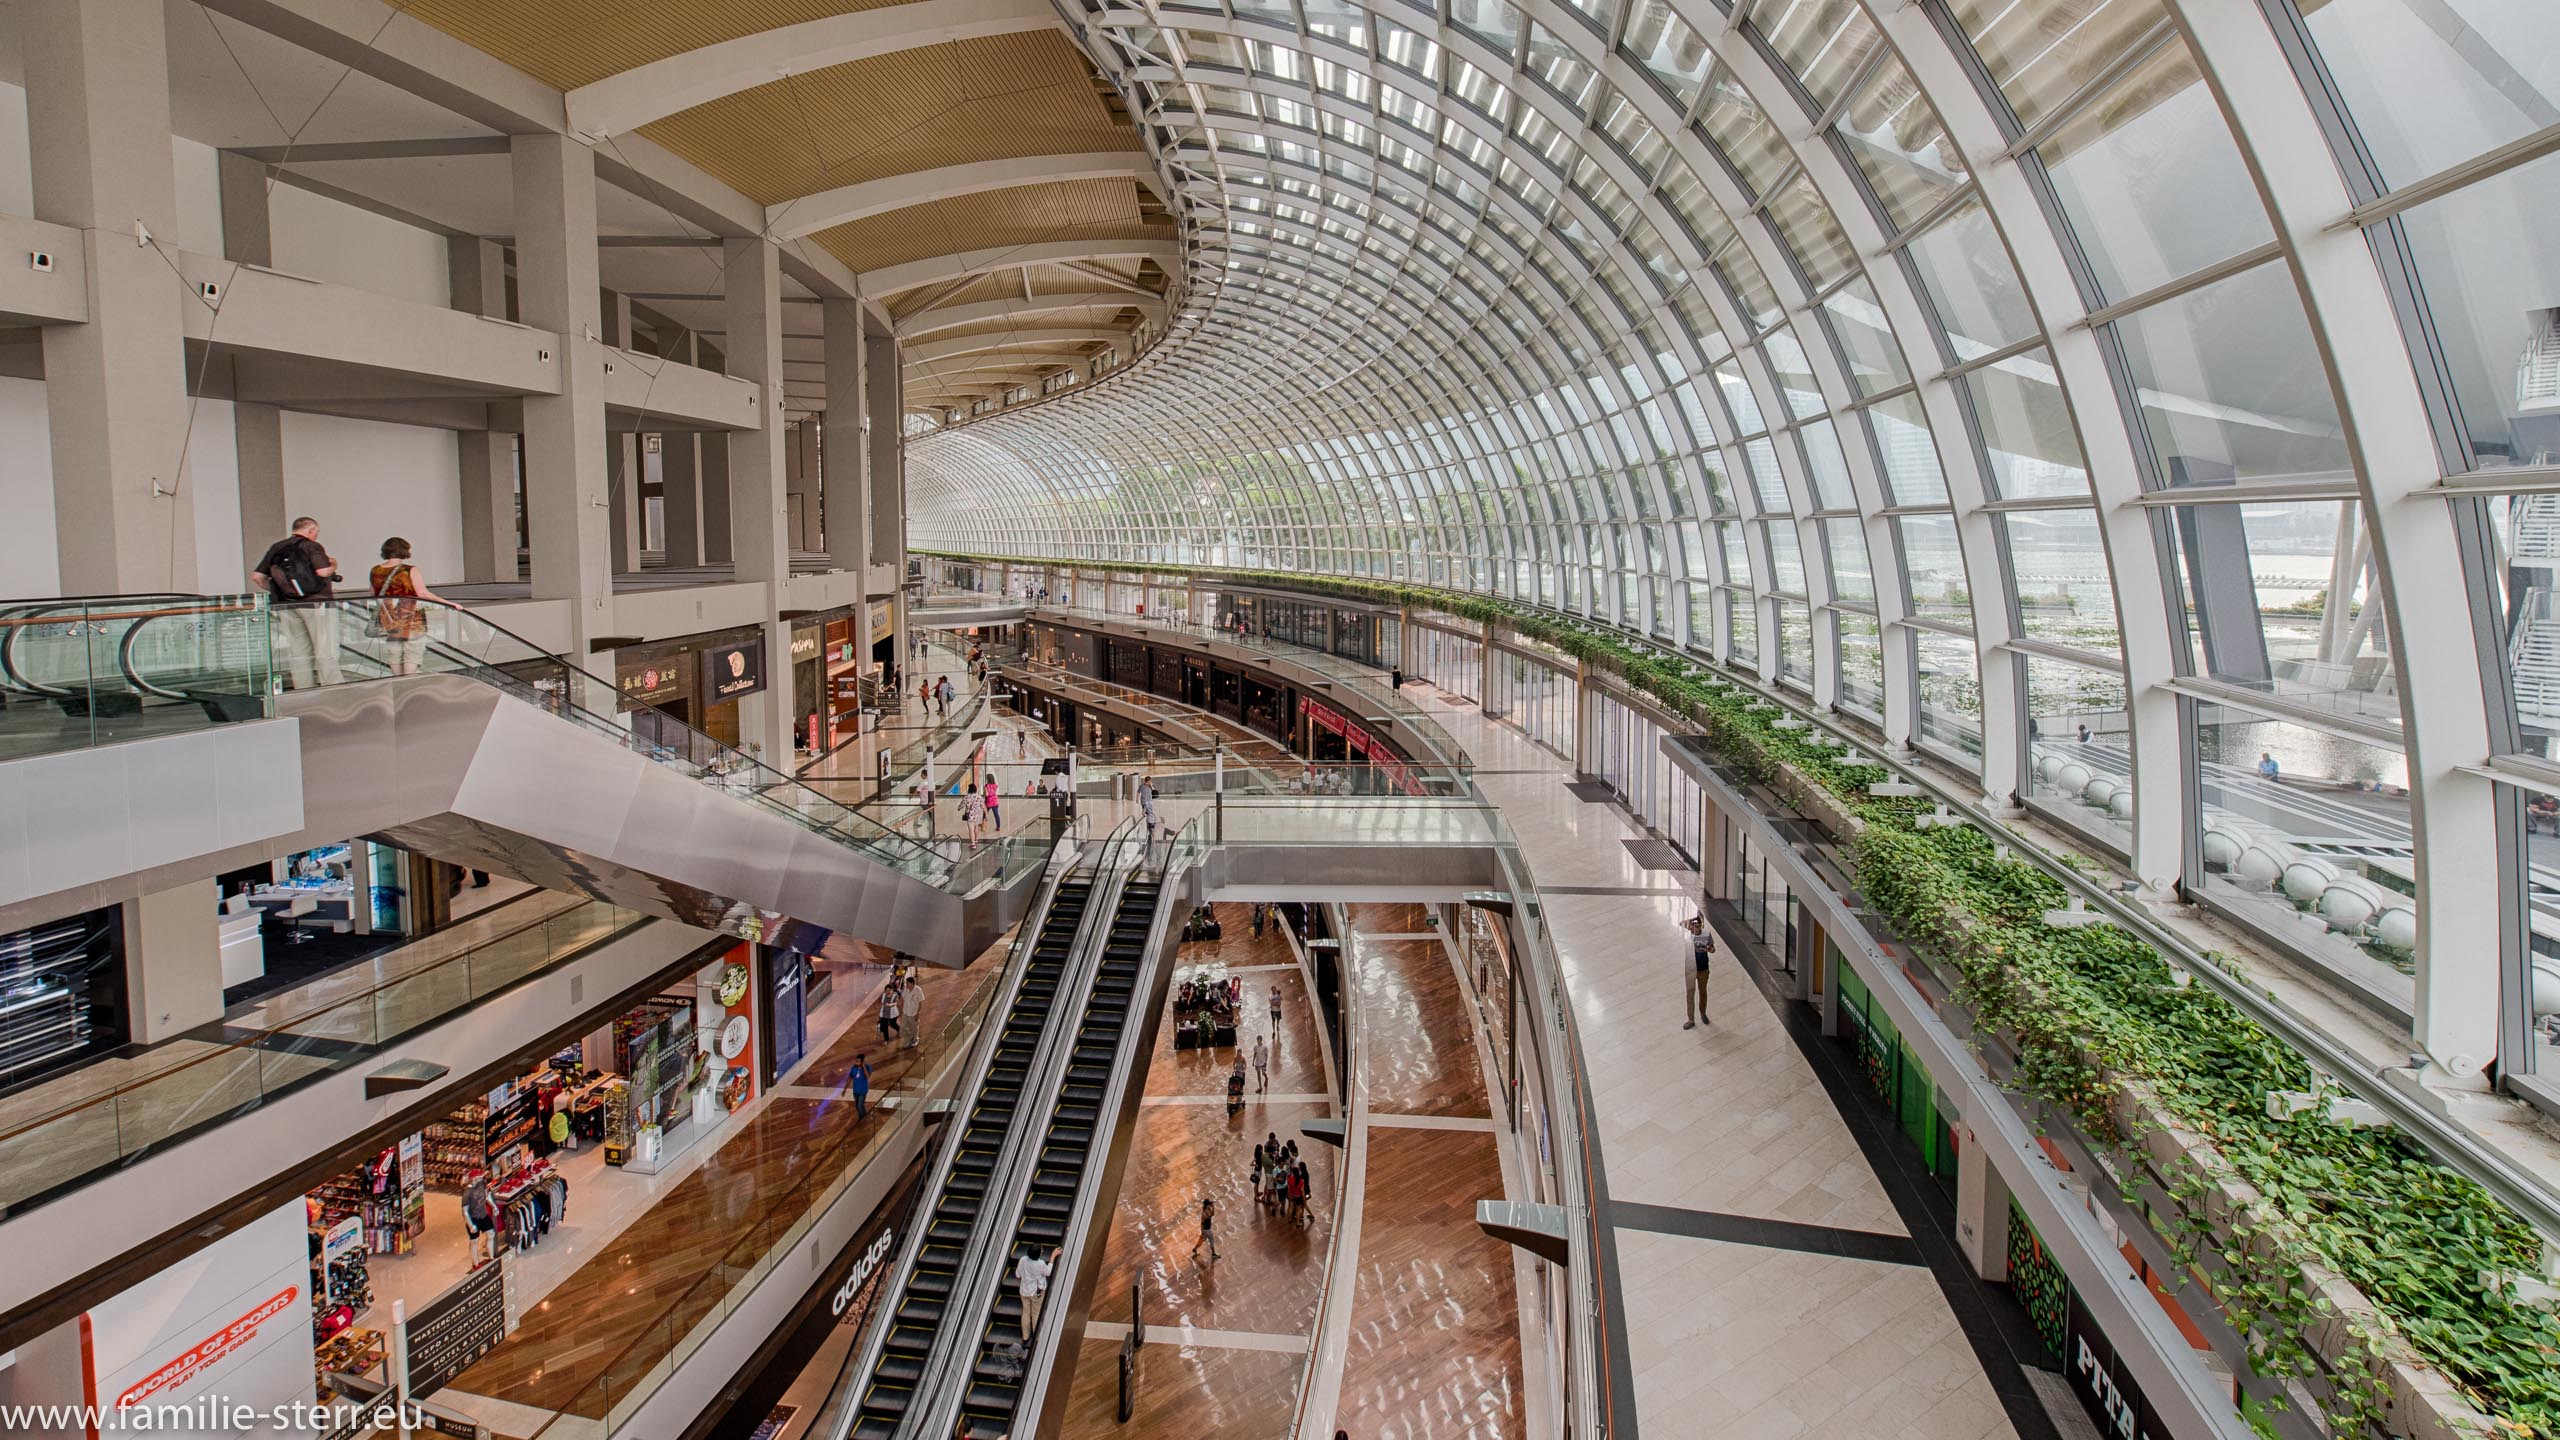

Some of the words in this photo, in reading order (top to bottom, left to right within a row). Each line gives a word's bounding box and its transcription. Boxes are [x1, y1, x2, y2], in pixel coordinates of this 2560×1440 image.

[1055, 798, 1060, 807] 1
[460, 1271, 489, 1294] CASINO
[832, 1227, 893, 1316] adidas
[130, 1353, 197, 1402] WORLD
[201, 1335, 227, 1356] OF
[229, 1293, 290, 1339] SPORTS
[413, 1307, 466, 1344] MASTERCARD
[418, 1340, 442, 1360] EXPO
[451, 1297, 502, 1336] CONVENTION
[432, 1345, 461, 1367] HOTEL
[469, 1314, 502, 1342] SKYPARK
[168, 1368, 196, 1392] PLAY
[197, 1349, 227, 1372] YOUR
[228, 1329, 258, 1353] GAME
[2077, 1334, 2135, 1440] PITA
[444, 1421, 473, 1433] MUSEUM
